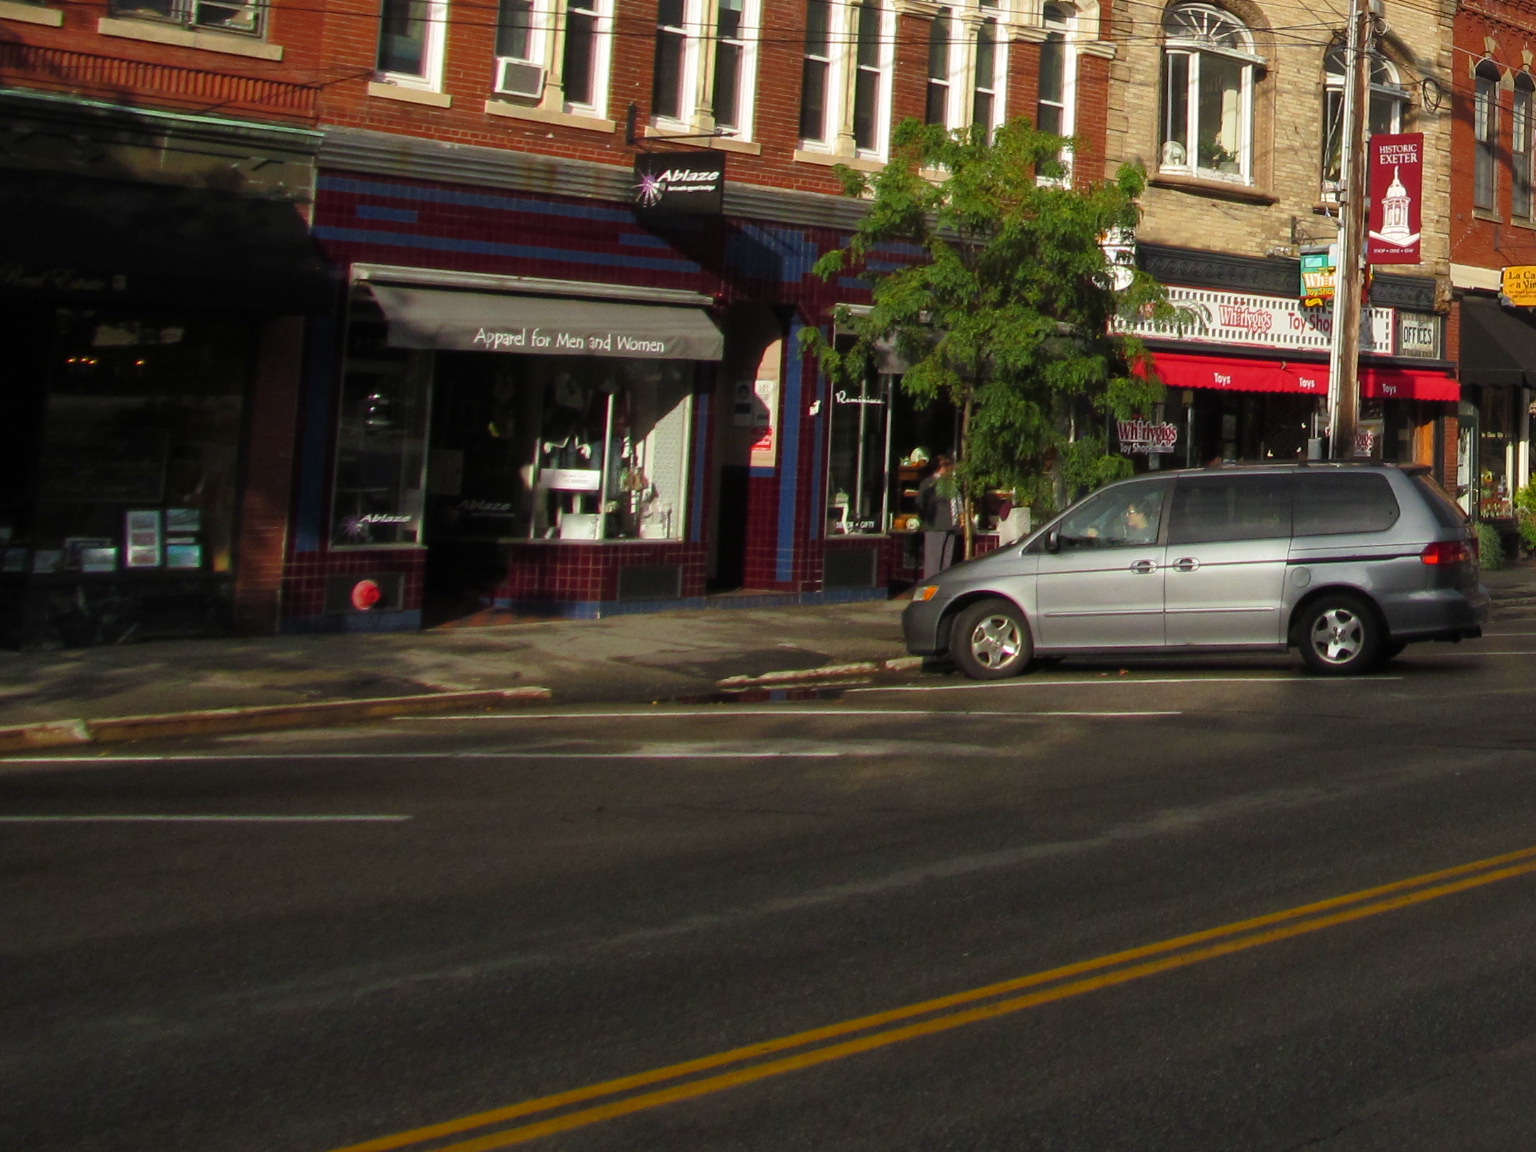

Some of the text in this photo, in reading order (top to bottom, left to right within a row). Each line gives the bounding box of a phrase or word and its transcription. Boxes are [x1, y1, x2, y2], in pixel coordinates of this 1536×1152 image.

[1379, 143, 1418, 154] HISTORIC
[1380, 152, 1418, 165] EXETER
[656, 169, 721, 183] Ablaze
[1508, 271, 1521, 280] La
[1219, 305, 1272, 334] Whirlygigs
[1287, 312, 1308, 334] Toy
[473, 327, 665, 353] Apparel for Men and Women
[1403, 326, 1432, 344] OFFICES
[1213, 372, 1232, 387] Toys
[1299, 377, 1316, 390] Toys
[1382, 383, 1397, 396] Toys
[1117, 419, 1178, 447] Whirlygigs
[1120, 442, 1150, 455] Toy Shop
[457, 499, 512, 512] Ablaze
[359, 512, 412, 524] Ablaze
